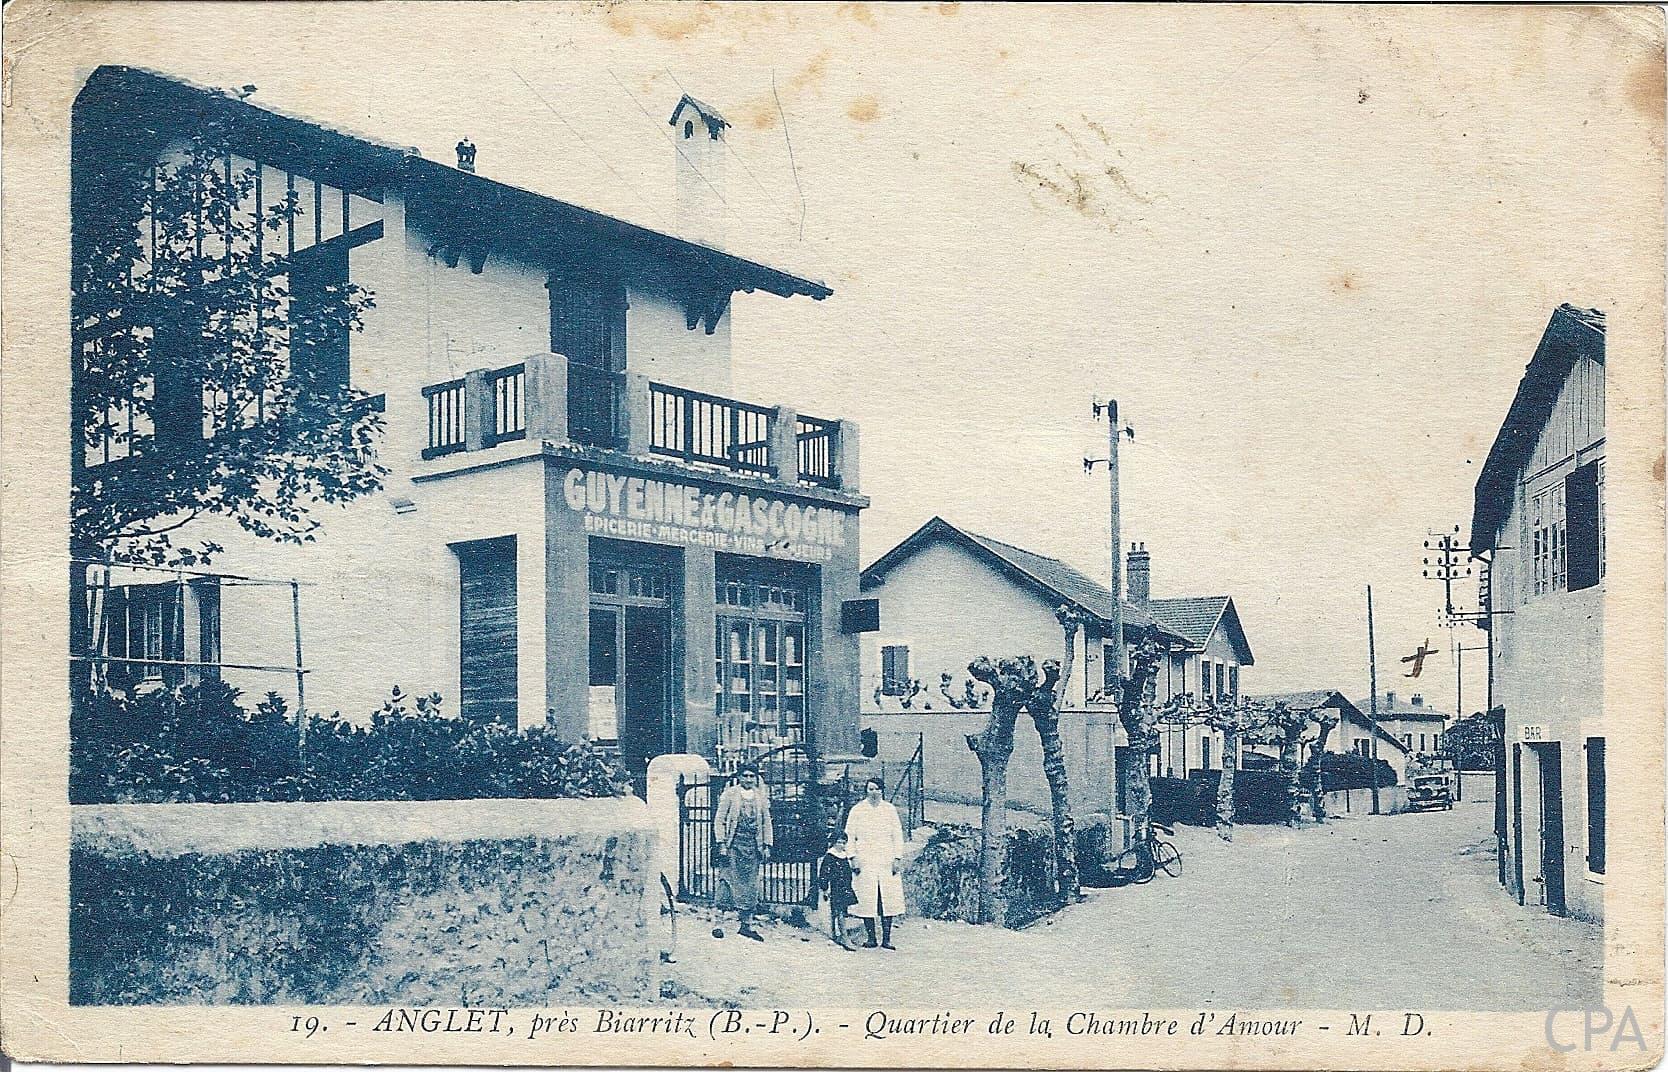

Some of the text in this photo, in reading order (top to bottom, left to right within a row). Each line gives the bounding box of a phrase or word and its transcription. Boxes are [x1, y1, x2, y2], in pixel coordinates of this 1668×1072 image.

[564, 468, 700, 527] GUYENNE
[716, 491, 846, 546] GASCOGNE
[659, 525, 727, 550] MERCERIE
[1524, 726, 1542, 740] BAR
